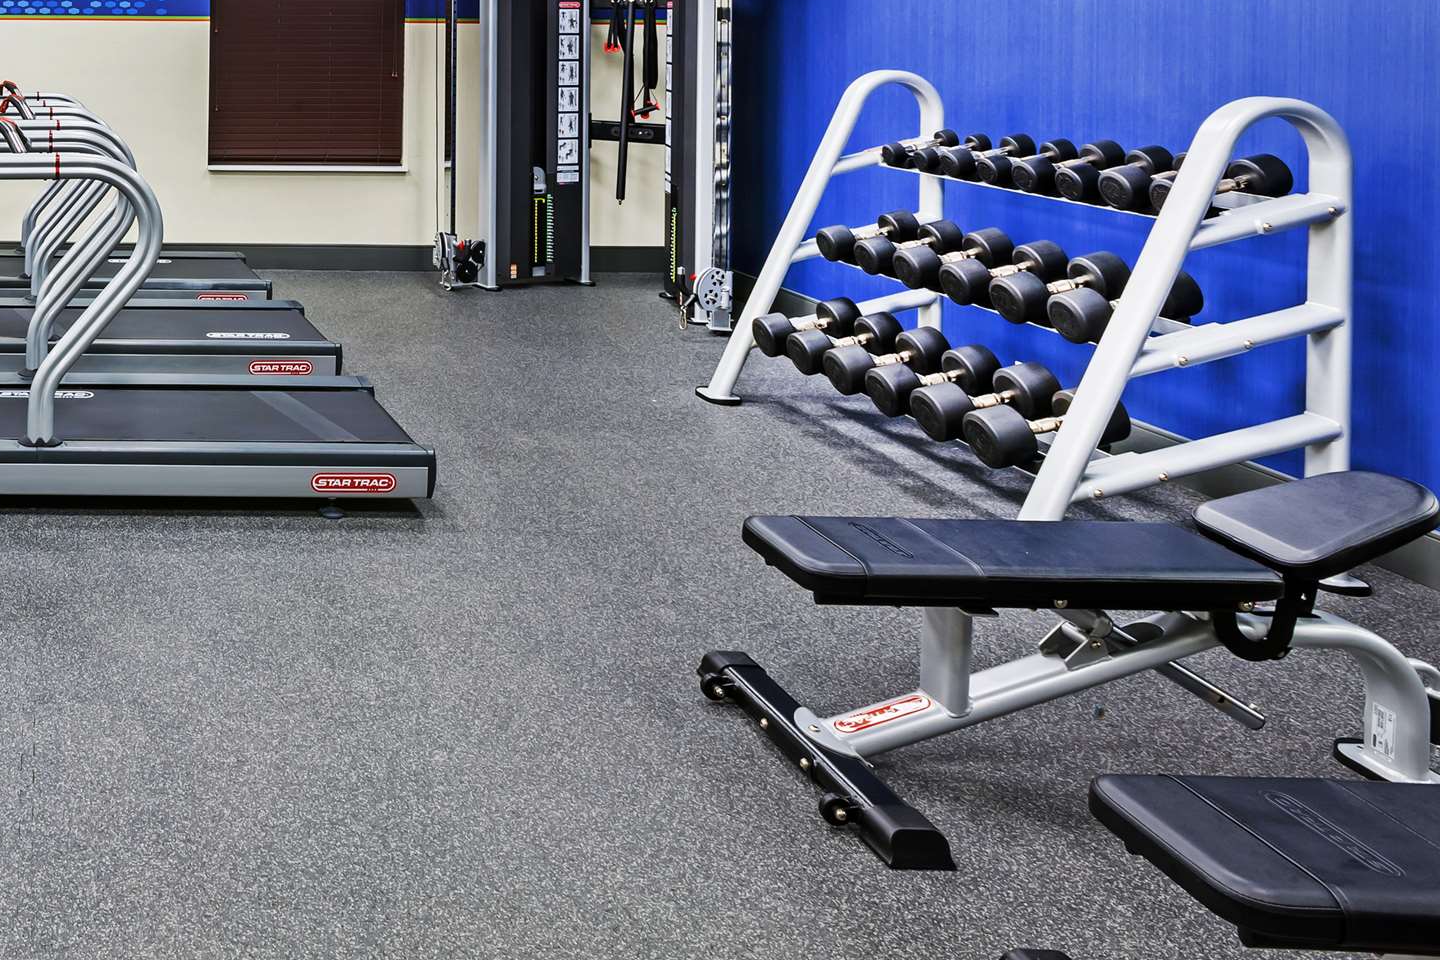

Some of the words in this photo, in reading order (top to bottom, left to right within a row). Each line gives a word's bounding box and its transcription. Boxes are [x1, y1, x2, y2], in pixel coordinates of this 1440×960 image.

[252, 364, 279, 372] STAR
[280, 364, 308, 372] TRAC
[315, 478, 351, 487] STAR
[353, 478, 389, 487] TRAC
